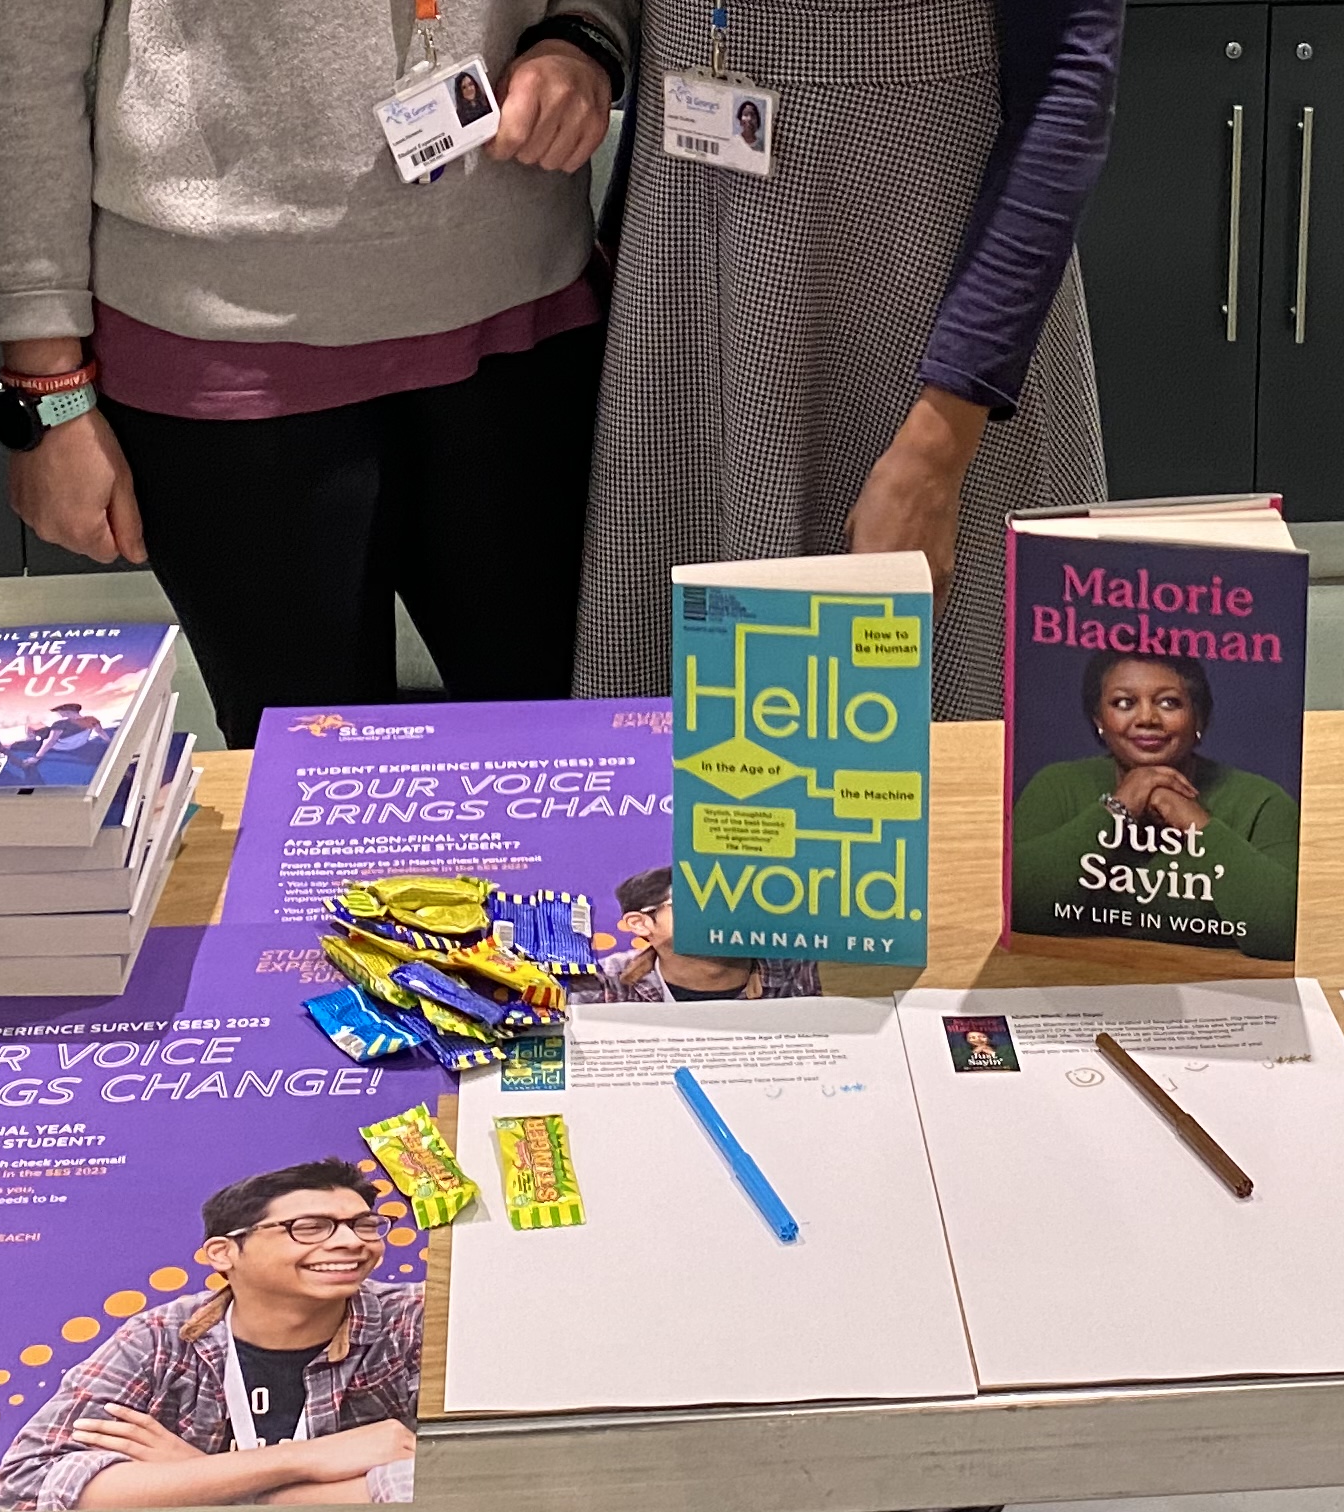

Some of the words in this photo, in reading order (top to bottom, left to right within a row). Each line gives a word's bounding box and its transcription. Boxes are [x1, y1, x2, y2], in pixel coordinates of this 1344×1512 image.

[1062, 563, 1254, 617] Malorie
[29, 628, 122, 640] STAMPER
[864, 629, 892, 640] How
[895, 629, 909, 640] to
[1032, 604, 1283, 663] Blackman
[16, 640, 67, 657] THE
[855, 643, 871, 654] Be
[875, 644, 918, 654] Human
[24, 676, 81, 697] US
[686, 652, 898, 743] Hello
[338, 726, 358, 737] St
[362, 724, 435, 738] George's
[296, 765, 375, 776] STUDENT
[378, 761, 480, 774] EXPERIENCE
[484, 759, 549, 770] SURVEY
[553, 758, 594, 768] (SES)
[598, 757, 636, 767] 2023
[700, 760, 713, 772] In
[716, 761, 736, 773] the
[740, 764, 764, 776] Age
[768, 765, 781, 775] of
[297, 777, 439, 802] YOUR
[460, 770, 615, 796] VOICE
[840, 788, 860, 799] the
[864, 789, 915, 801] Machine
[289, 800, 489, 827] BRINGS
[1097, 813, 1206, 858] Just
[678, 838, 923, 921] world.
[1078, 852, 1225, 905] Sayin'
[1054, 902, 1085, 920] MY
[1091, 907, 1133, 927] LIFE
[1140, 912, 1162, 929] IN
[1169, 915, 1247, 937] WORDS
[709, 929, 829, 950] HANNAH
[847, 936, 895, 954] FRY
[90, 1020, 168, 1034] SURVEY
[173, 1018, 221, 1032] (SES)
[226, 1017, 271, 1029] 2023
[57, 1036, 242, 1070] VOICE
[100, 1067, 384, 1104] CHANGE!
[35, 1123, 86, 1135] YEAR
[2, 1135, 106, 1149] STUDENT?
[11, 1158, 52, 1169] check
[54, 1157, 86, 1168] your
[87, 1155, 127, 1165] email
[2, 1170, 15, 1178] in
[19, 1169, 42, 1178] the
[75, 1167, 107, 1176] 2023
[32, 1195, 47, 1204] to
[49, 1194, 68, 1203] be
